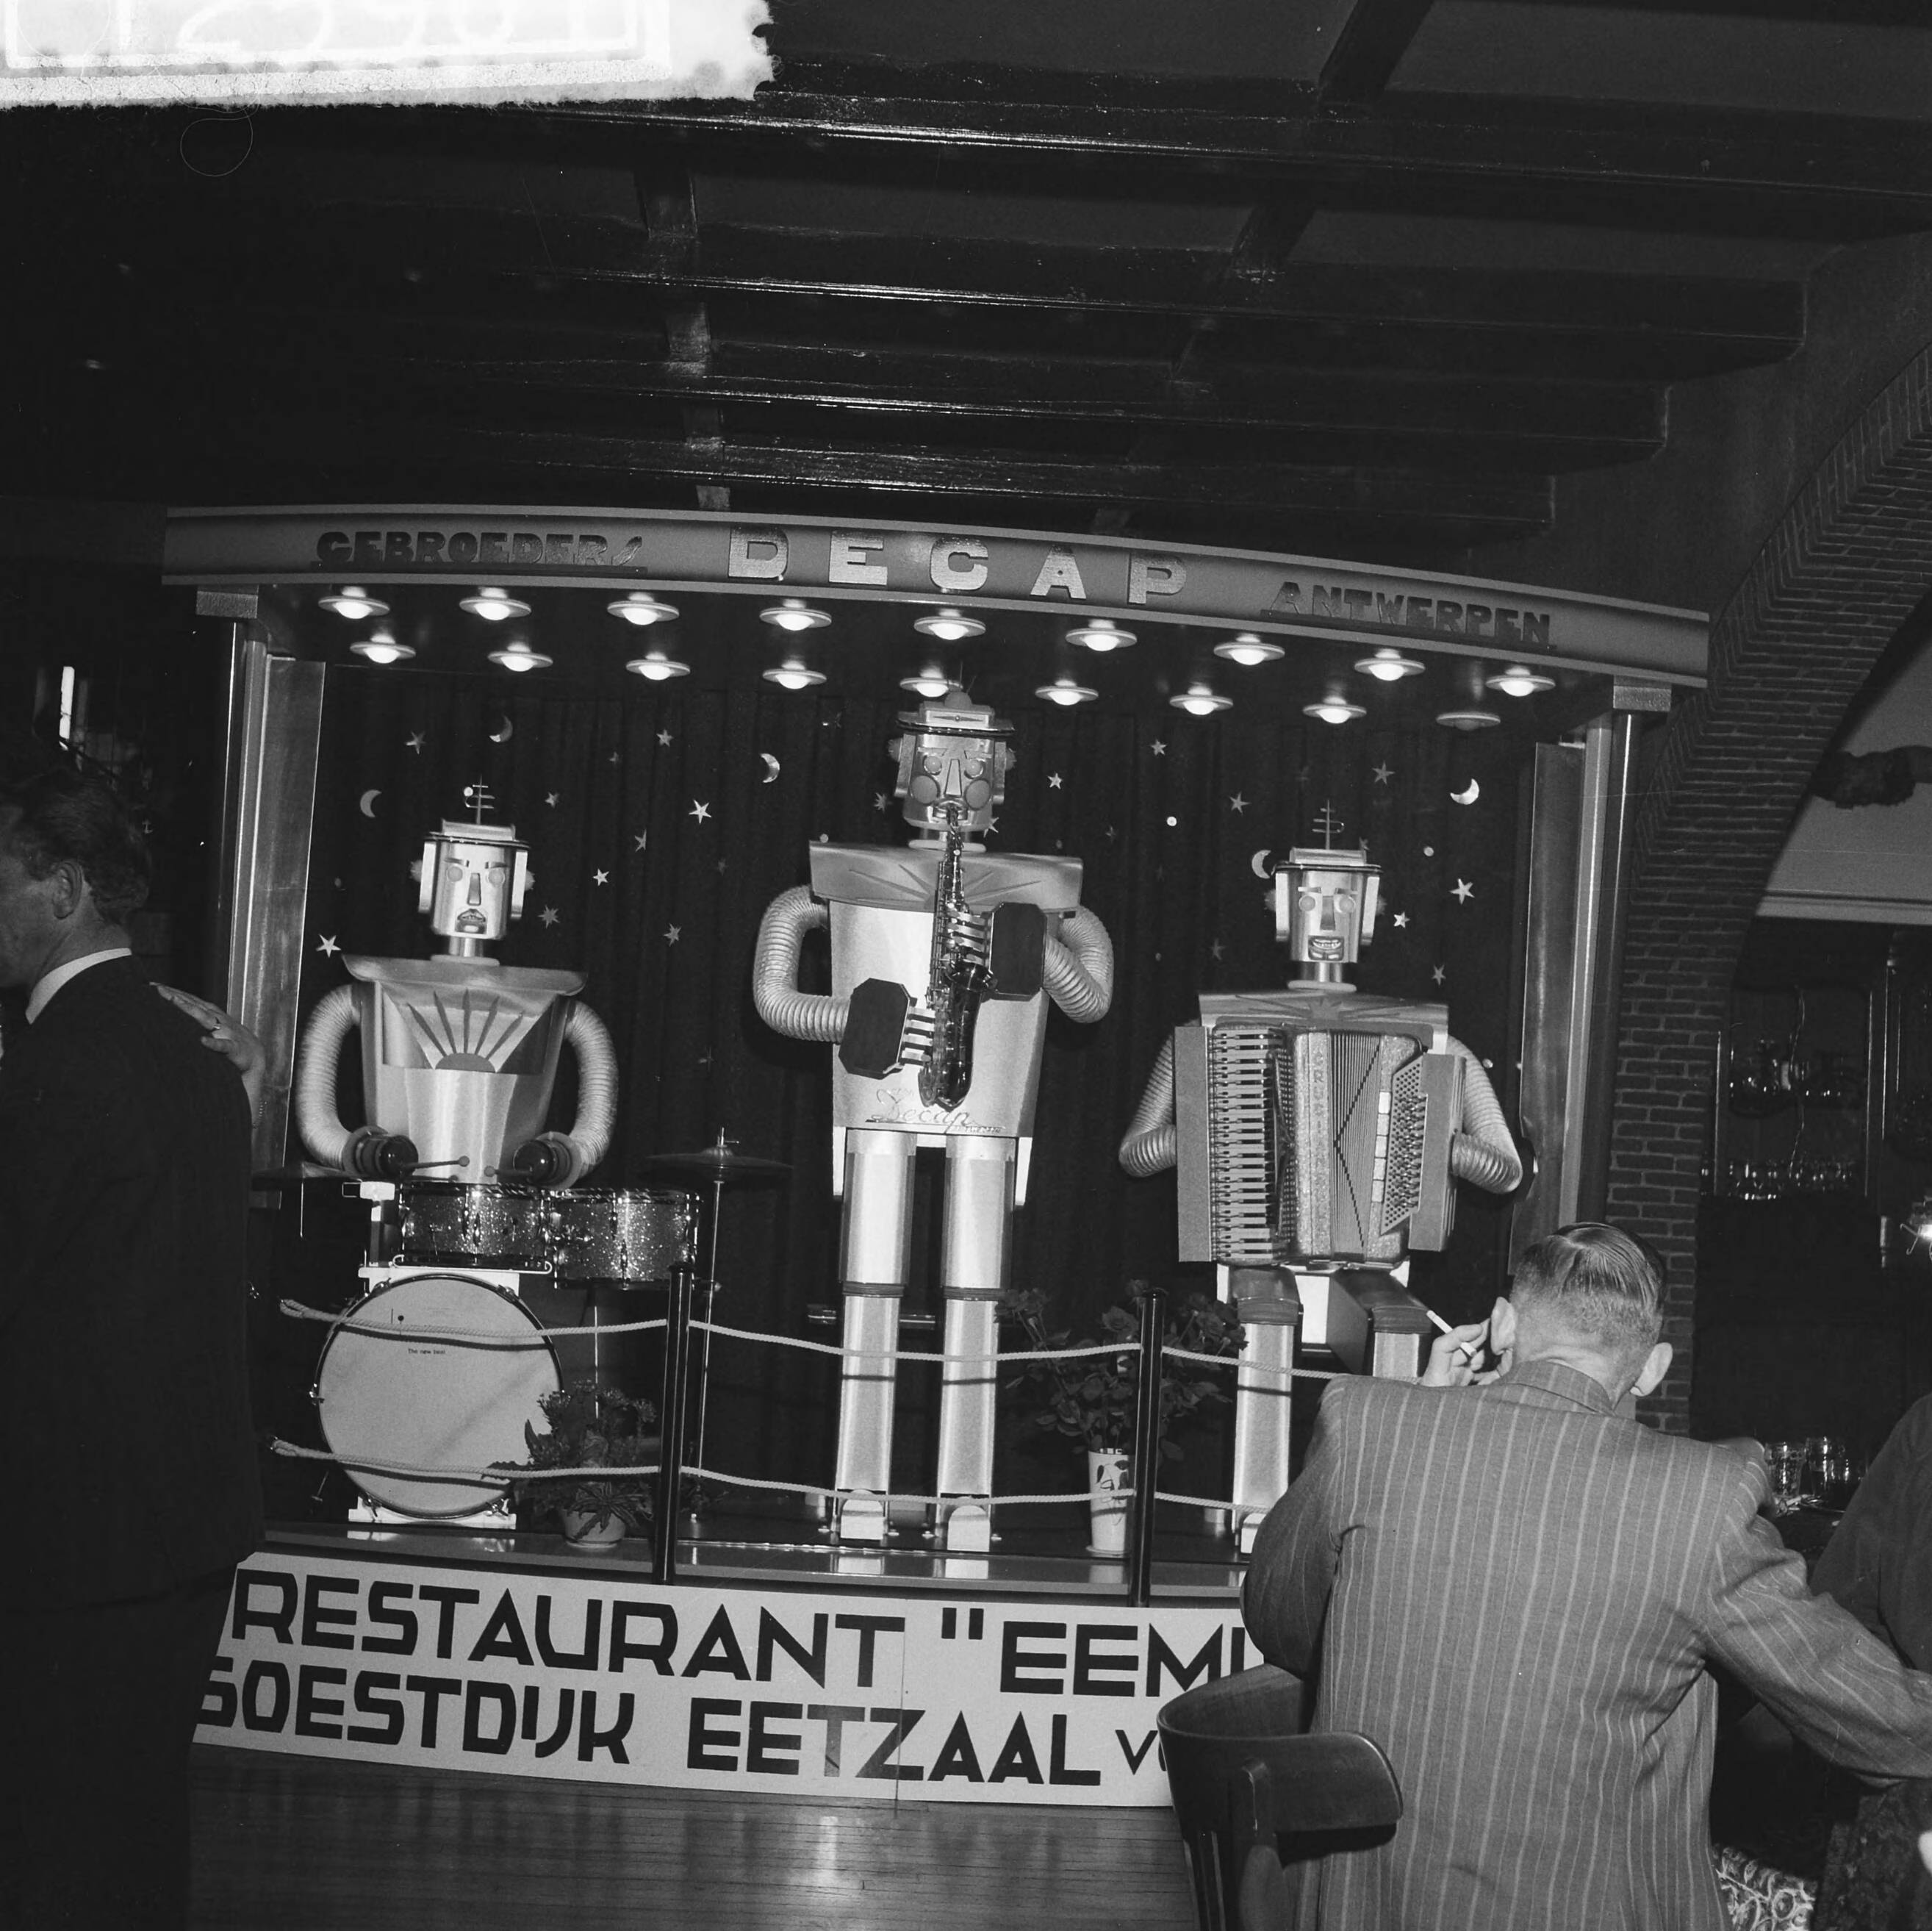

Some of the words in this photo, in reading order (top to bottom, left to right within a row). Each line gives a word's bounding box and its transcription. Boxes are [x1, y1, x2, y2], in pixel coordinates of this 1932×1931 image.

[728, 525, 1187, 604] DECAP
[1268, 581, 1551, 644] ANTWERPEN
[231, 1568, 905, 1689] RESTAURANT
[686, 1697, 1101, 1786] EETZAAL
